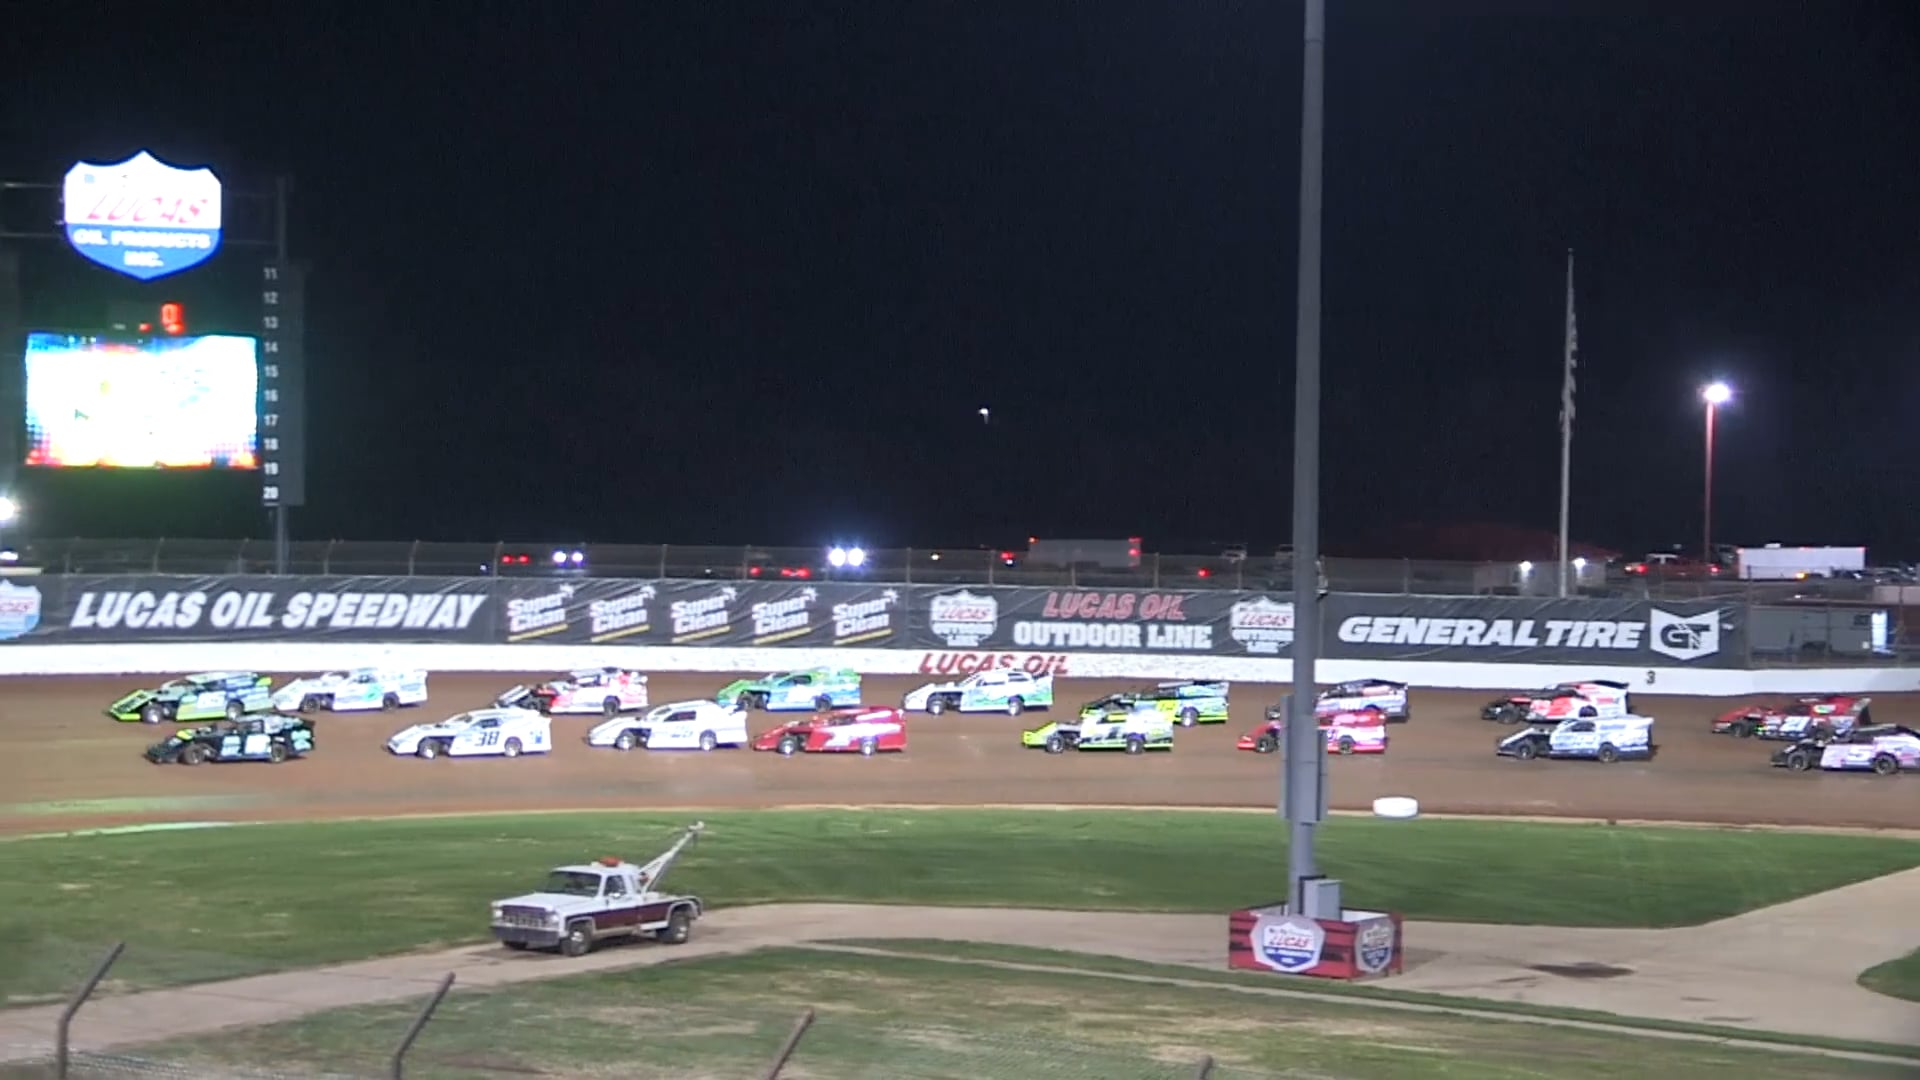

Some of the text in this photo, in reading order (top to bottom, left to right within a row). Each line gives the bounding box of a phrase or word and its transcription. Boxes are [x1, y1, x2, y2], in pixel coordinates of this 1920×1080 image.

[263, 267, 279, 280] 11
[263, 291, 279, 304] 12
[263, 316, 279, 329] 13
[263, 414, 279, 427] 17
[263, 486, 279, 499] 20
[70, 591, 206, 628] LUCAS
[210, 592, 274, 629] OIL
[281, 594, 487, 629] SPEEDWAY
[507, 590, 569, 617] Super
[590, 592, 651, 618] Super
[671, 595, 732, 618] Super
[752, 596, 813, 620] Super
[833, 598, 893, 621] Super
[1042, 592, 1187, 621] LUCAS OIL
[510, 608, 566, 632] Clean
[592, 609, 648, 633] Clean
[674, 611, 729, 634] Clean
[755, 612, 810, 635] Clean
[836, 614, 890, 637] Clean
[1013, 621, 1141, 647] OUTDOOR
[1147, 624, 1213, 649] LINE
[1339, 616, 1647, 649] GENERAL TIRE
[918, 653, 1068, 675] LUCAS OIL
[1646, 670, 1656, 684] 3
[475, 731, 500, 747] 38
